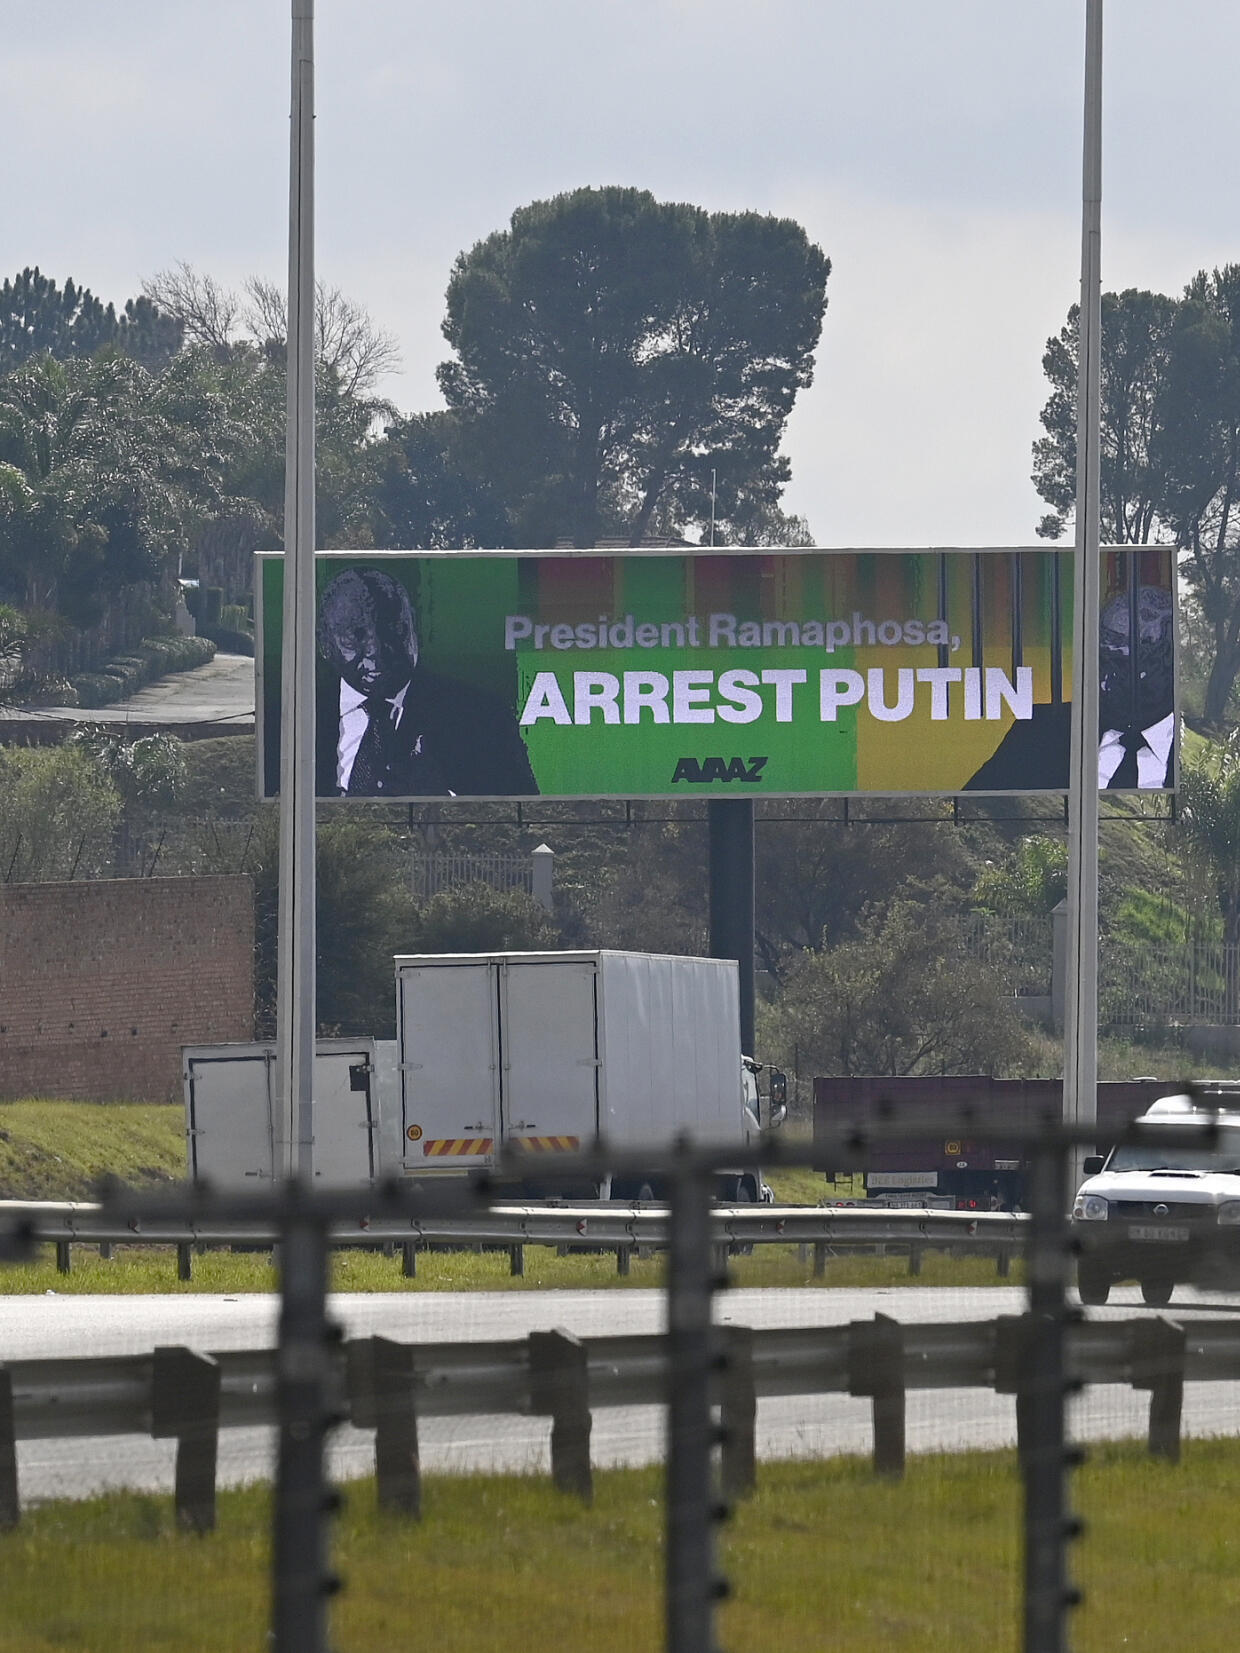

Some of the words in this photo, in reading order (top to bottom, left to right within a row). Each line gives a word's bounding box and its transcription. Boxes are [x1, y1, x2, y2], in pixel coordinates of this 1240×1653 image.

[504, 614, 700, 650] President
[708, 611, 962, 653] Ramaphosa,
[519, 668, 807, 725] ARREST
[819, 666, 1033, 722] PUTIN
